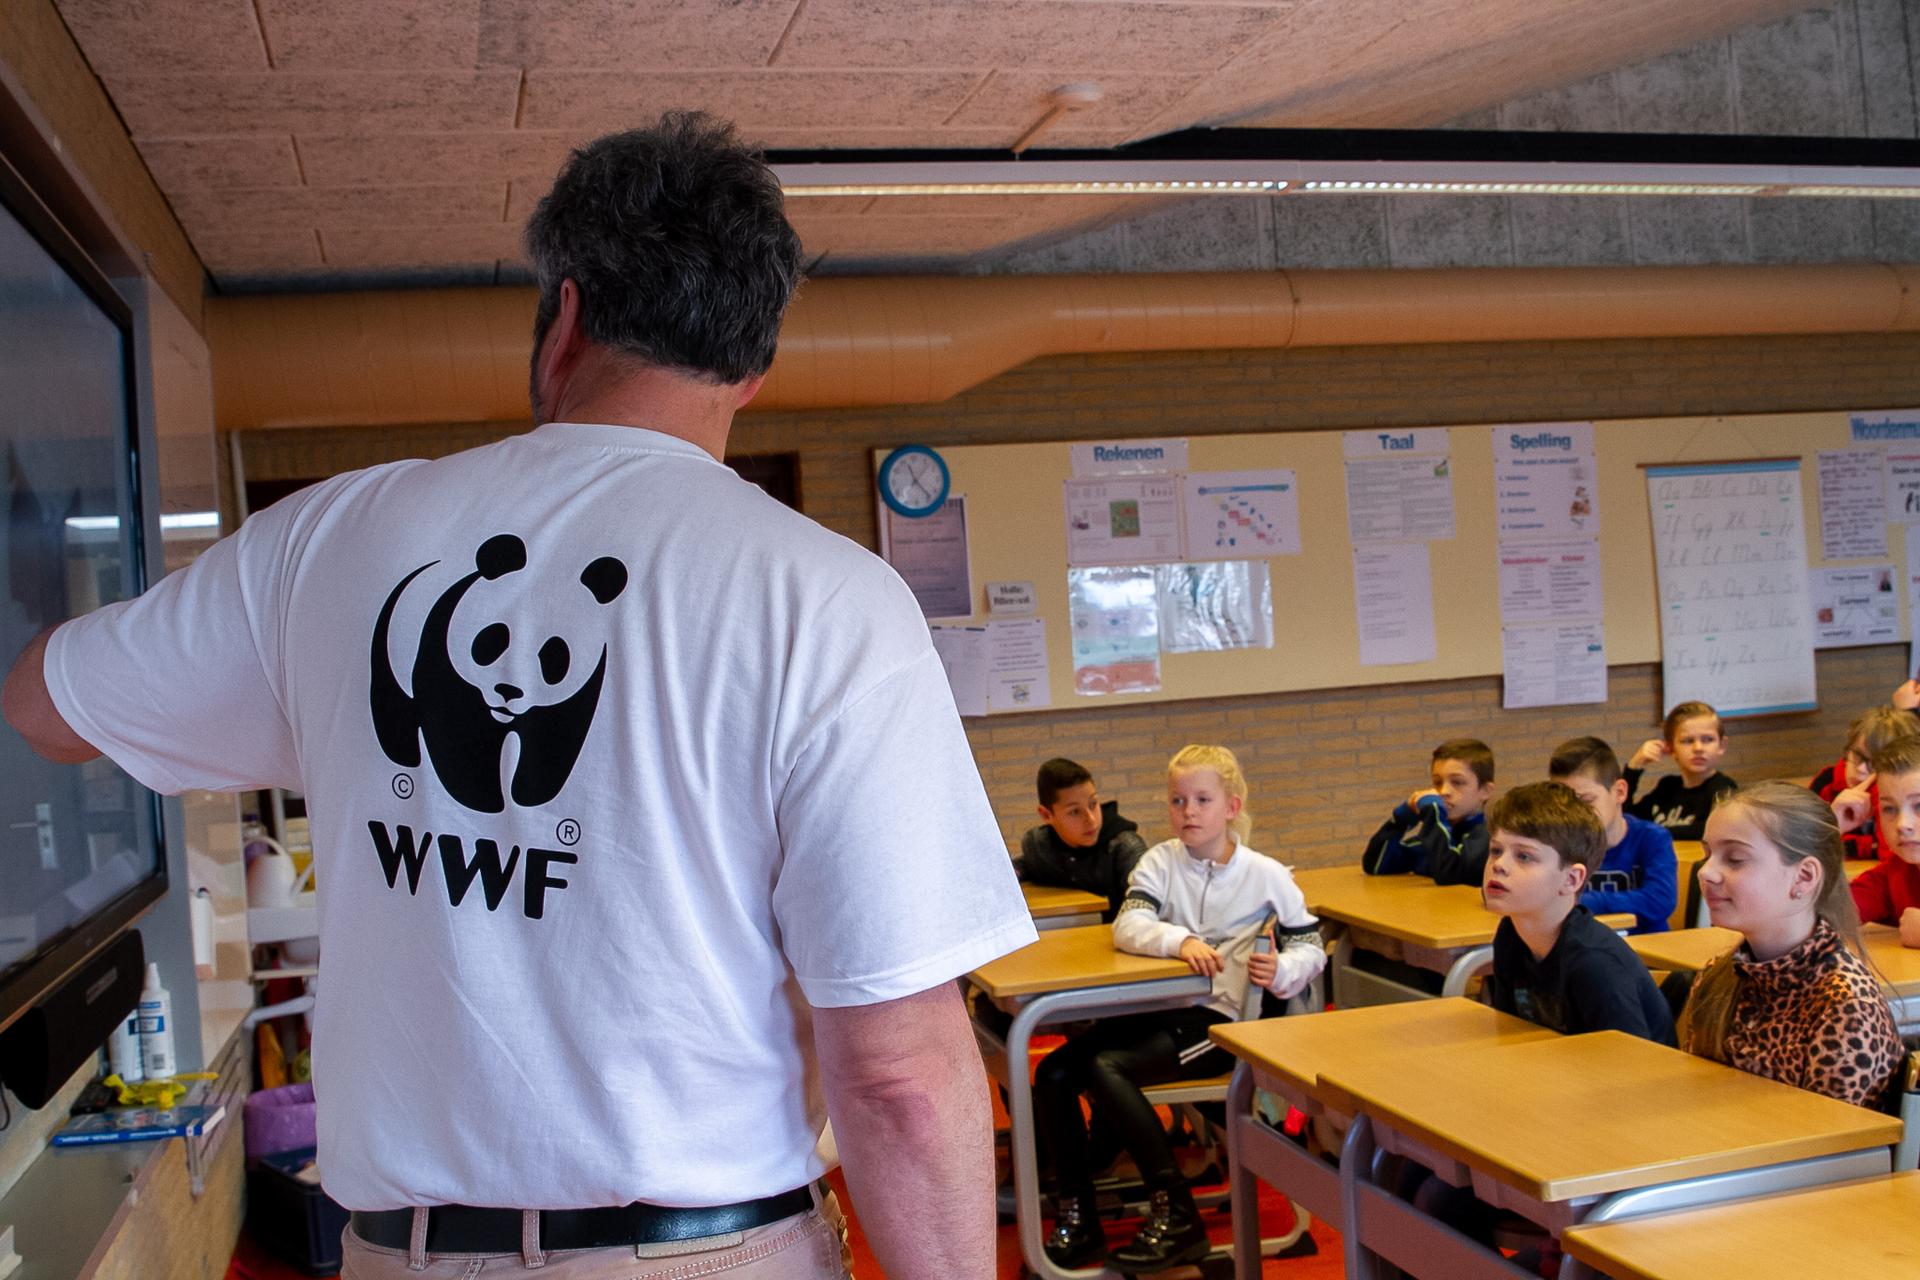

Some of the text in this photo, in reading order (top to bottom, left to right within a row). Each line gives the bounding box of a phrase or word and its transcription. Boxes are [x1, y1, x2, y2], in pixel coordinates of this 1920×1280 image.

[1377, 433, 1414, 450] Taal
[1510, 432, 1571, 452] Spelling
[1093, 446, 1164, 462] Rekenen
[368, 820, 578, 920] WWF
